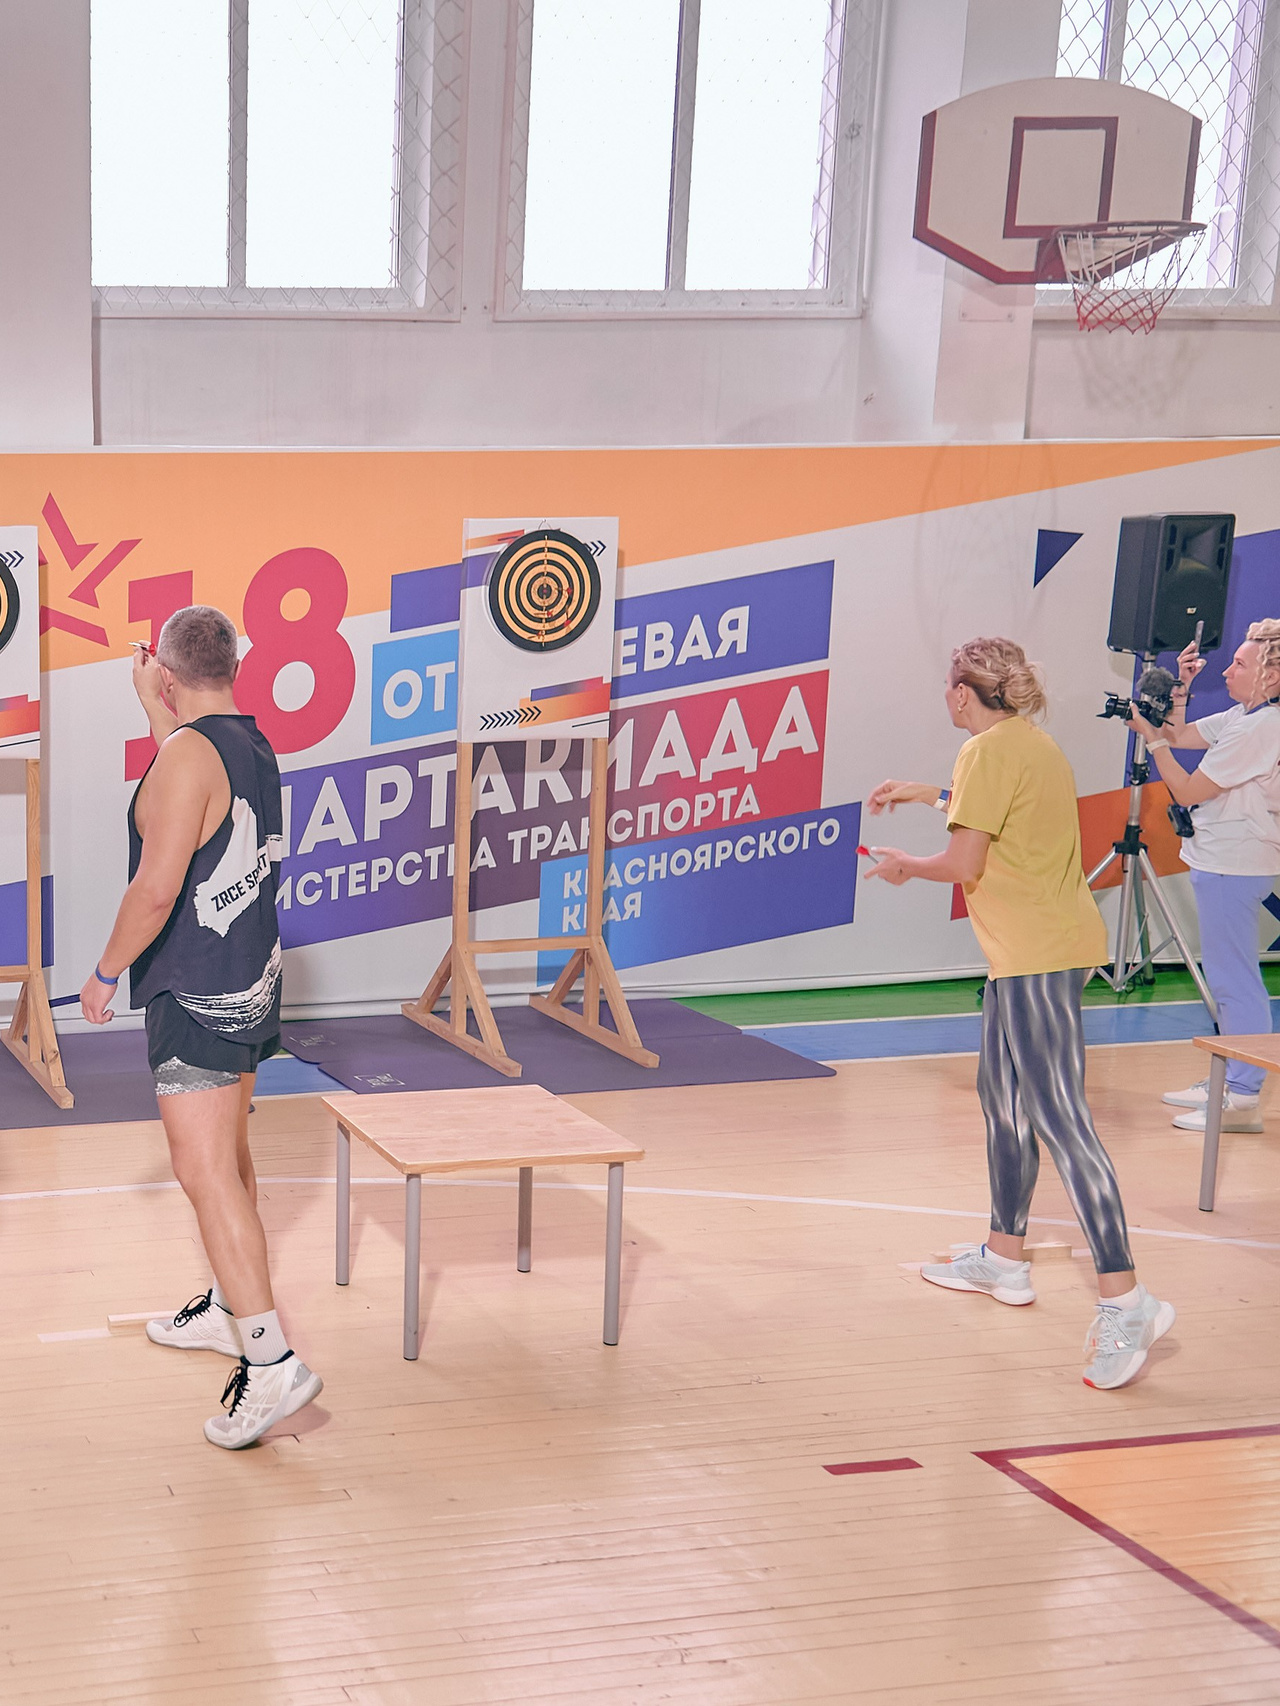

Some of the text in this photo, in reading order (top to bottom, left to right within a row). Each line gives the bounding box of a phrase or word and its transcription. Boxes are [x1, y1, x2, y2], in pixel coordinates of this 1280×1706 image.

[563, 817, 841, 899] КАСНОЯРСКОГО
[210, 880, 247, 913] ZRCE
[561, 891, 642, 933] КАЯ
